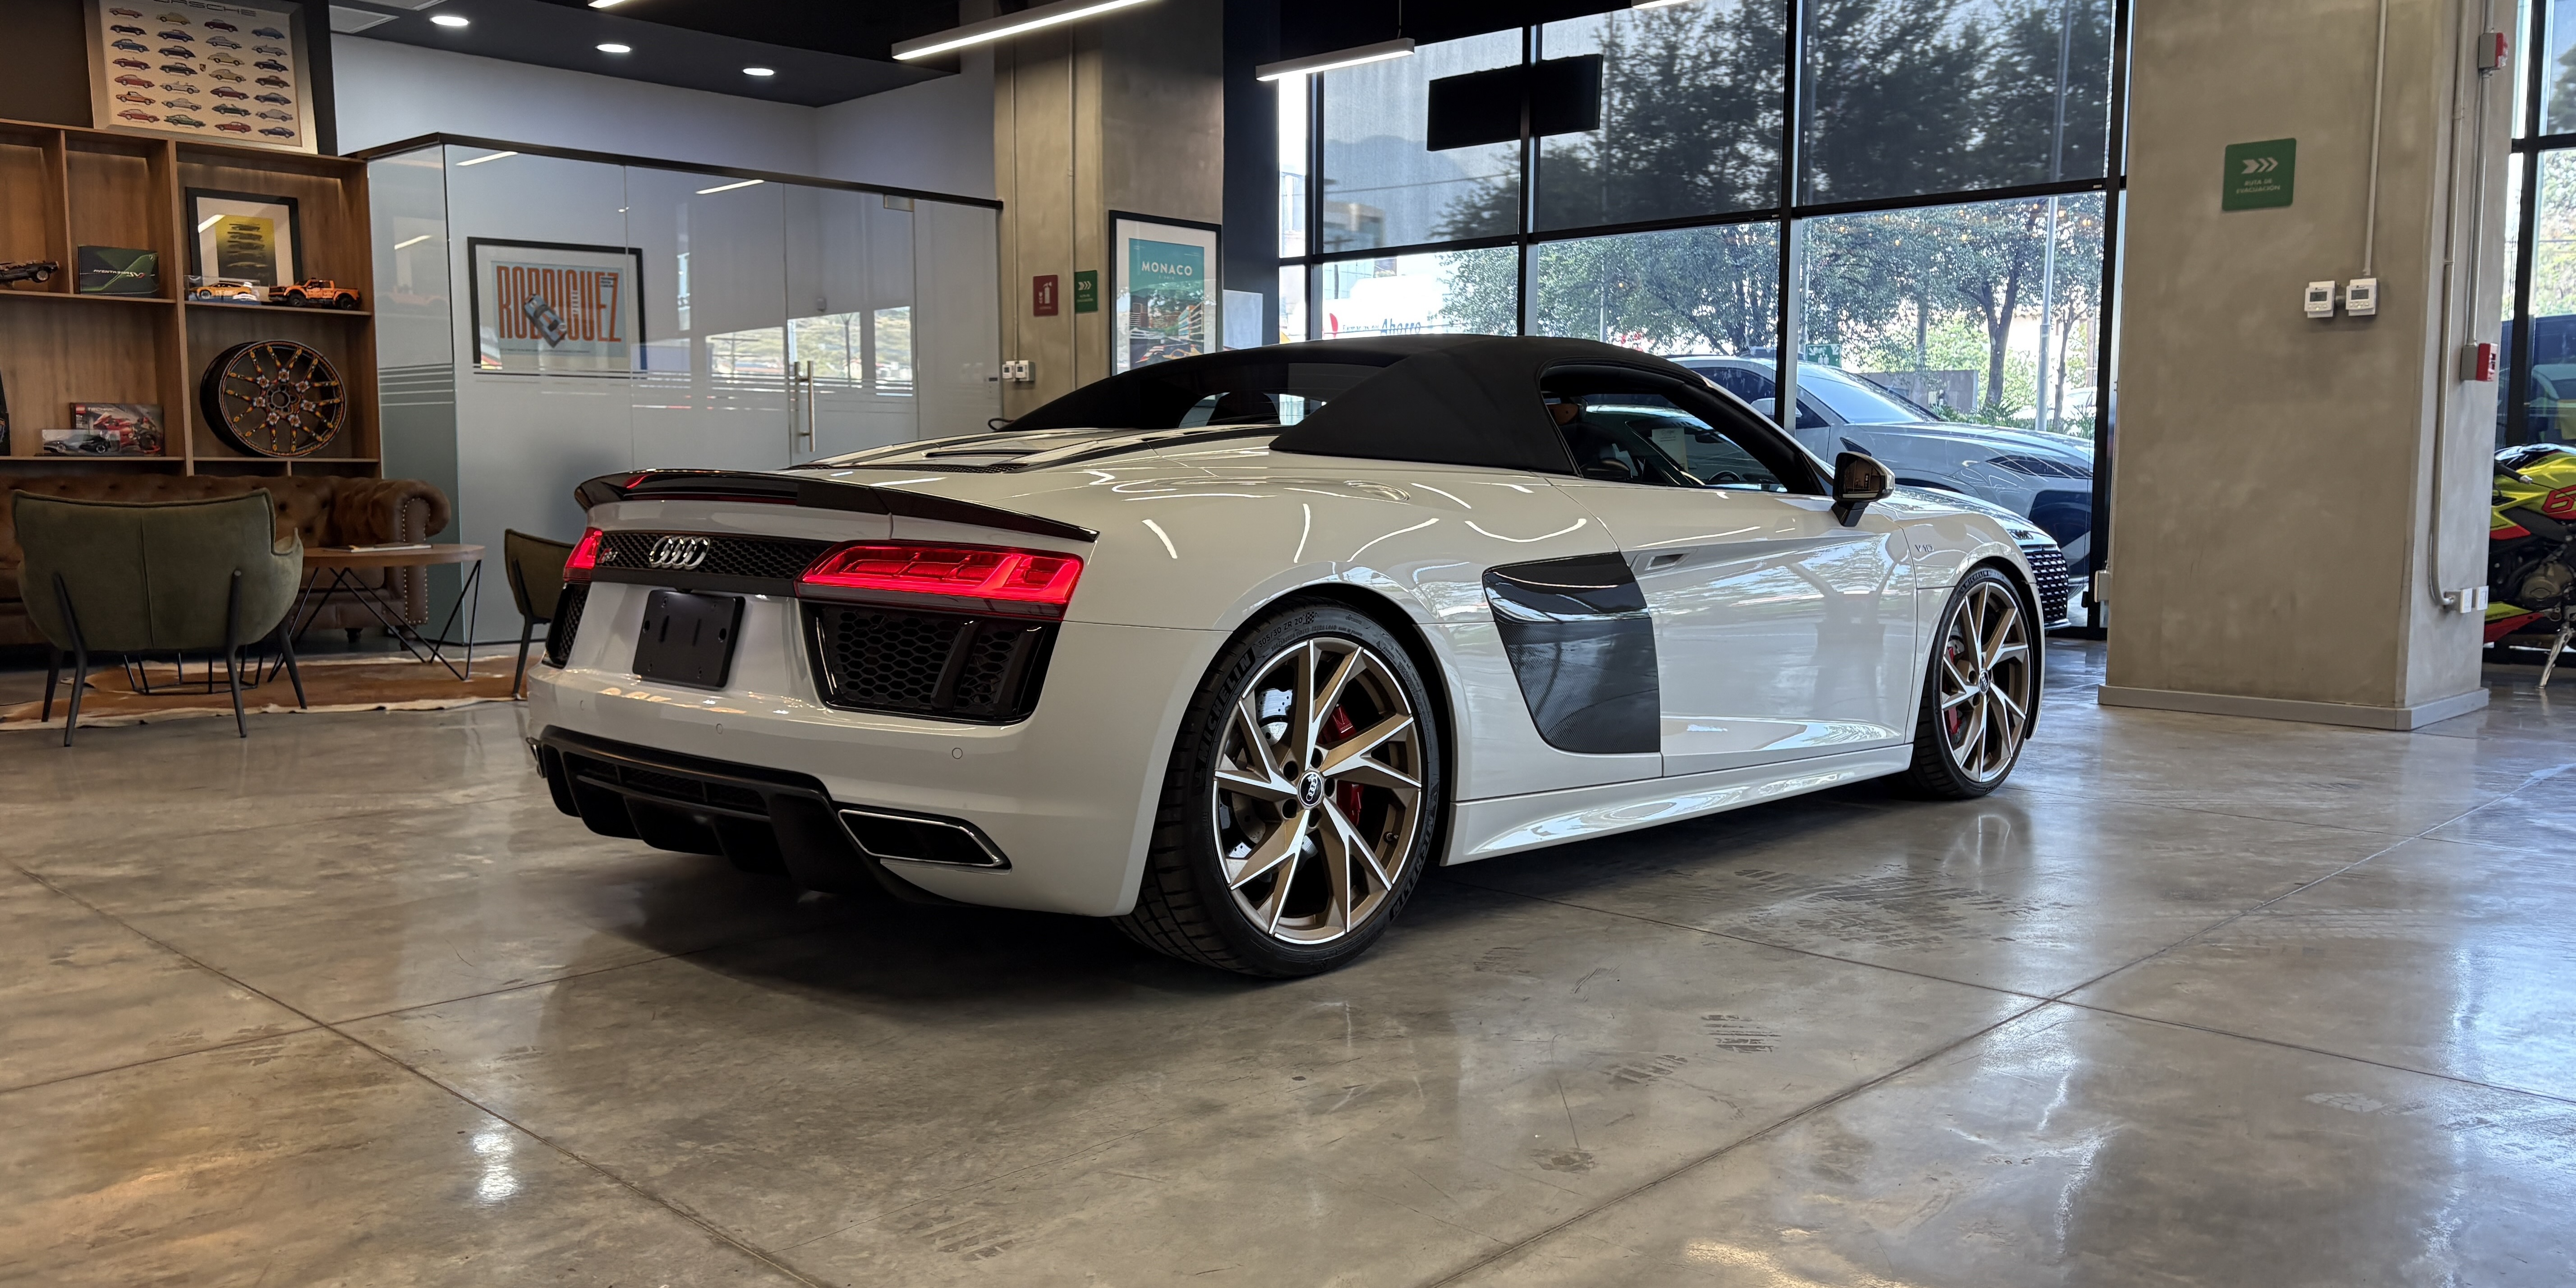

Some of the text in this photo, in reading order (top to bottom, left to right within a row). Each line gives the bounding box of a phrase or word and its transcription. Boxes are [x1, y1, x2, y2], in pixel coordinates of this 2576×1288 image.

[153, 0, 256, 17] RSCHE
[1141, 261, 1193, 276] MONACO
[497, 265, 621, 342] RODRIGUEZ
[1914, 544, 1934, 552] V10
[1258, 626, 1281, 648] 305/30
[1284, 620, 1293, 630] ZR
[1295, 616, 1303, 626] 20
[1198, 653, 1252, 763] MICHELIN
